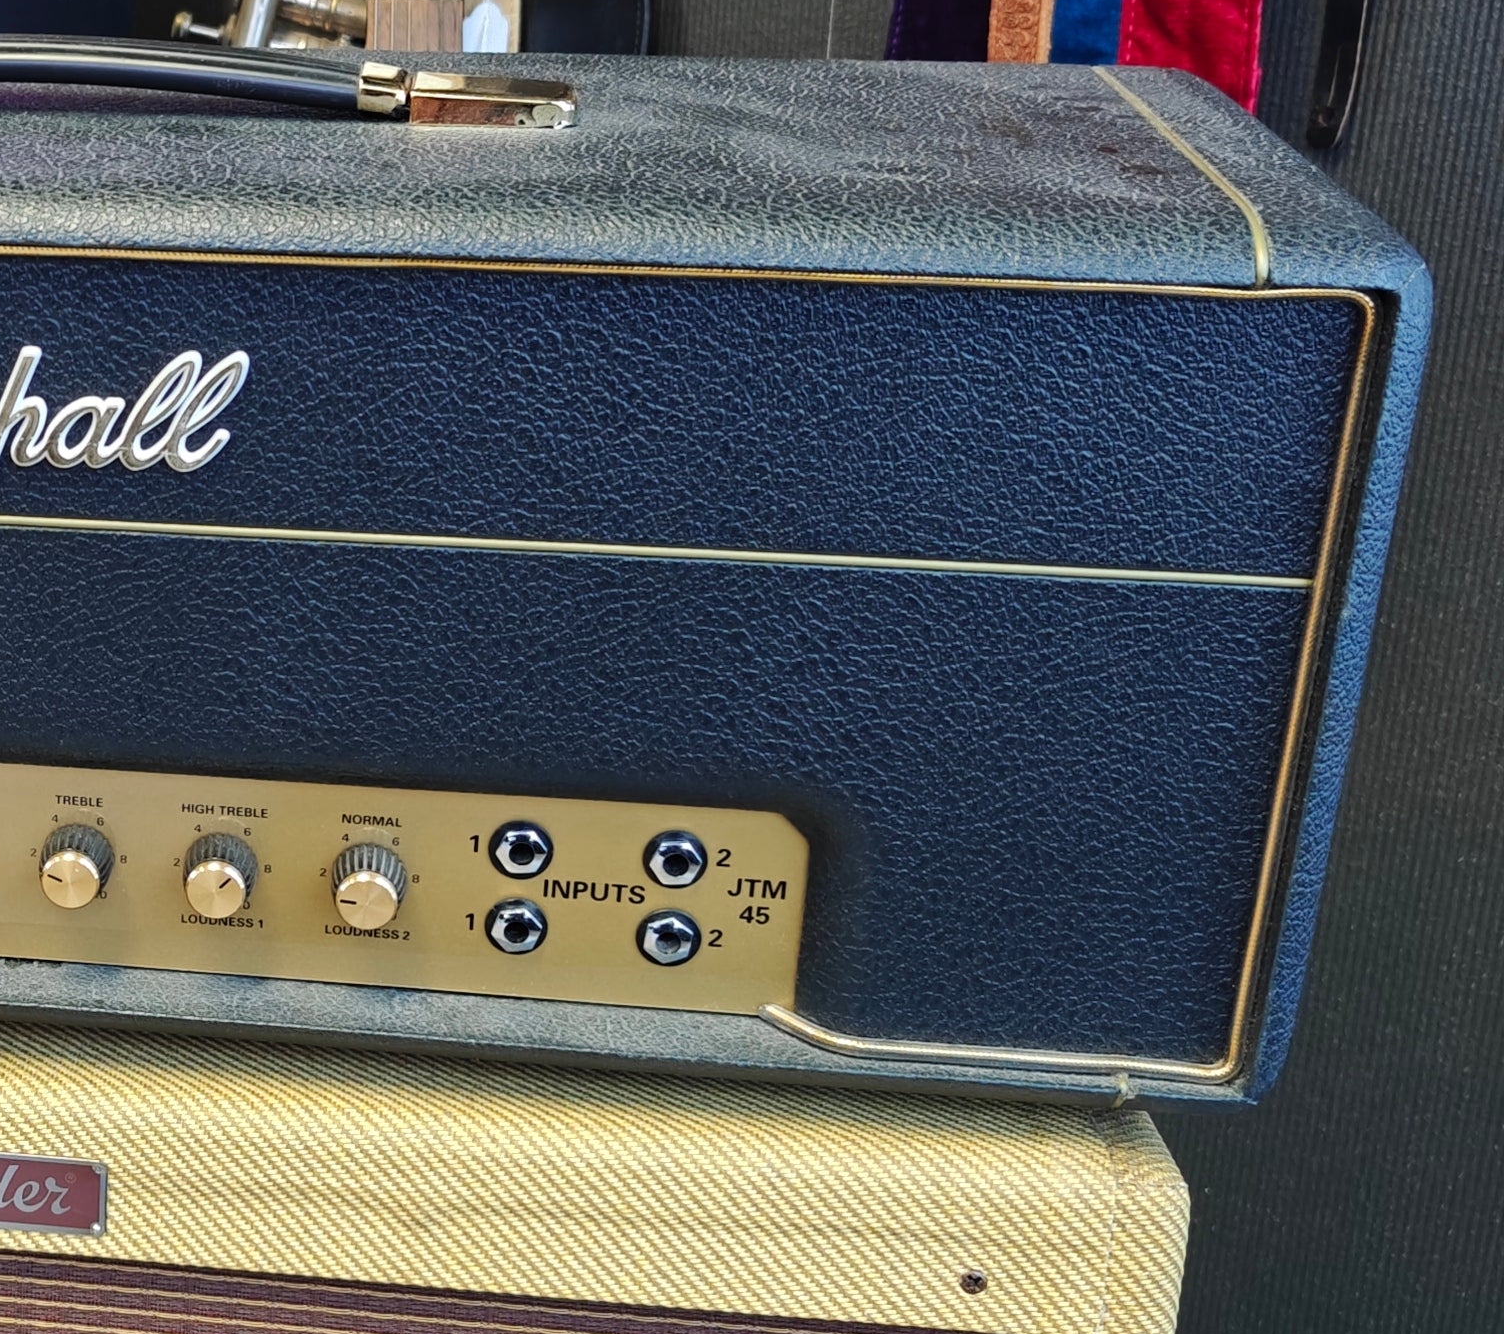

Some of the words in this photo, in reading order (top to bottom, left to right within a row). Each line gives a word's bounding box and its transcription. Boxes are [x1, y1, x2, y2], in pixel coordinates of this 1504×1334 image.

[55, 794, 104, 808] TREBLE
[181, 803, 215, 816] HIGH
[219, 805, 269, 819] TREBLE
[51, 814, 59, 823] 4
[96, 816, 105, 827] 6
[341, 813, 403, 828] NORMAL
[194, 824, 202, 833] 4
[243, 827, 252, 837] 6
[341, 833, 350, 843] 4
[392, 836, 400, 847] 6
[469, 834, 480, 853] 1
[30, 847, 38, 858] 2
[715, 848, 732, 867] 2
[119, 854, 128, 864] 8
[173, 857, 181, 867] 2
[263, 864, 272, 874] 8
[319, 867, 328, 877] 2
[411, 874, 420, 884] 8
[542, 878, 647, 905] INPUTS
[727, 877, 788, 900] JTM
[738, 905, 771, 925] 45
[180, 914, 254, 929] LOUDNESS
[257, 919, 264, 929] 1
[464, 912, 476, 931] 1
[324, 924, 400, 940] LOUDNESS
[402, 930, 411, 941] 2
[707, 929, 724, 948] 2
